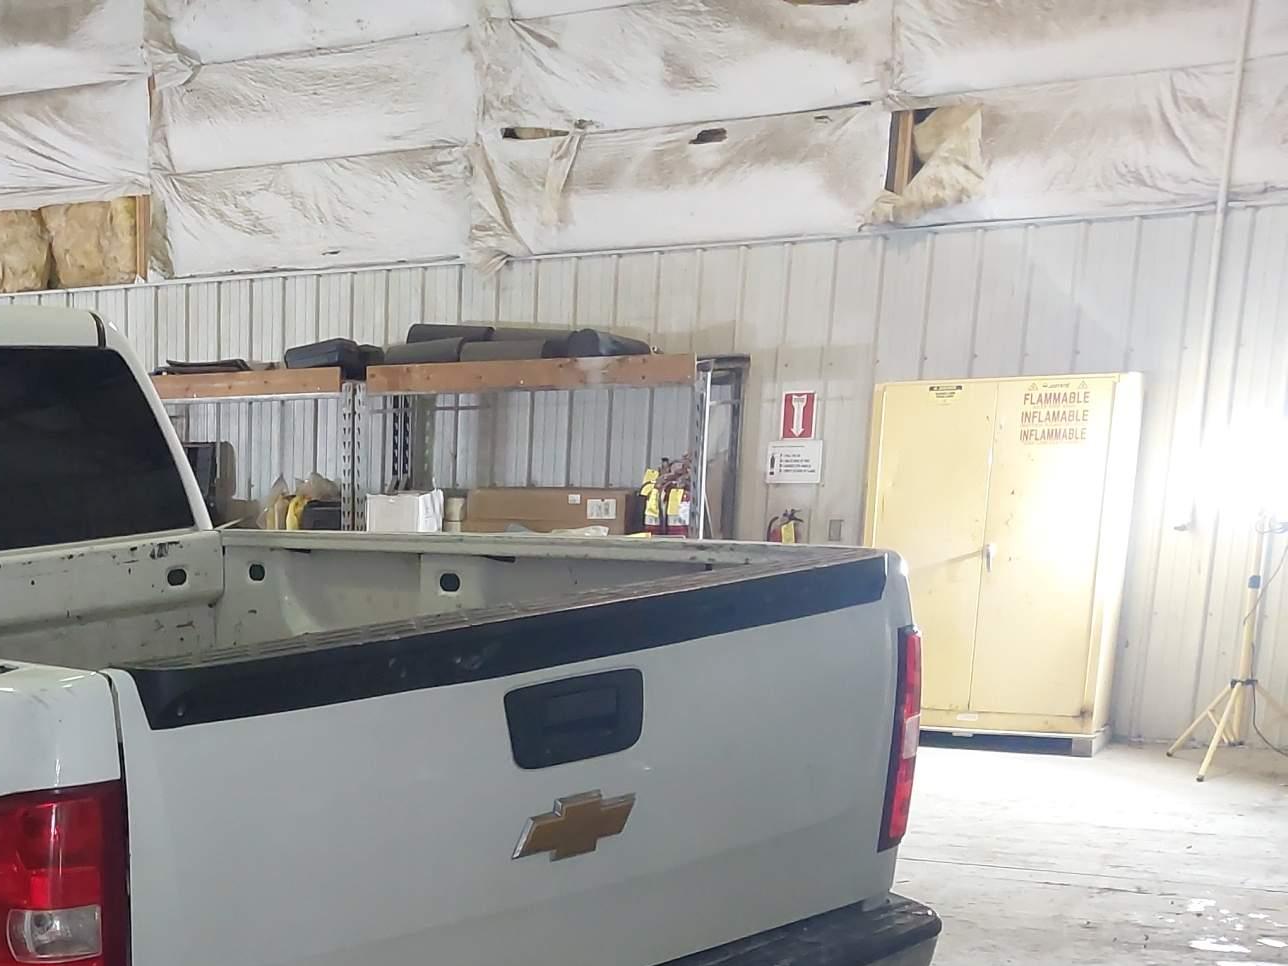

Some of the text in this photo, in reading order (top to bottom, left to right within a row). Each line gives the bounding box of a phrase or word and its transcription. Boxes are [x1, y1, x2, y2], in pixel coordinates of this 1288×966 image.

[1023, 391, 1091, 405] FLAMMABLE
[1020, 409, 1089, 424] INFLAMABLE
[1019, 427, 1088, 441] INFLAMMABLE
